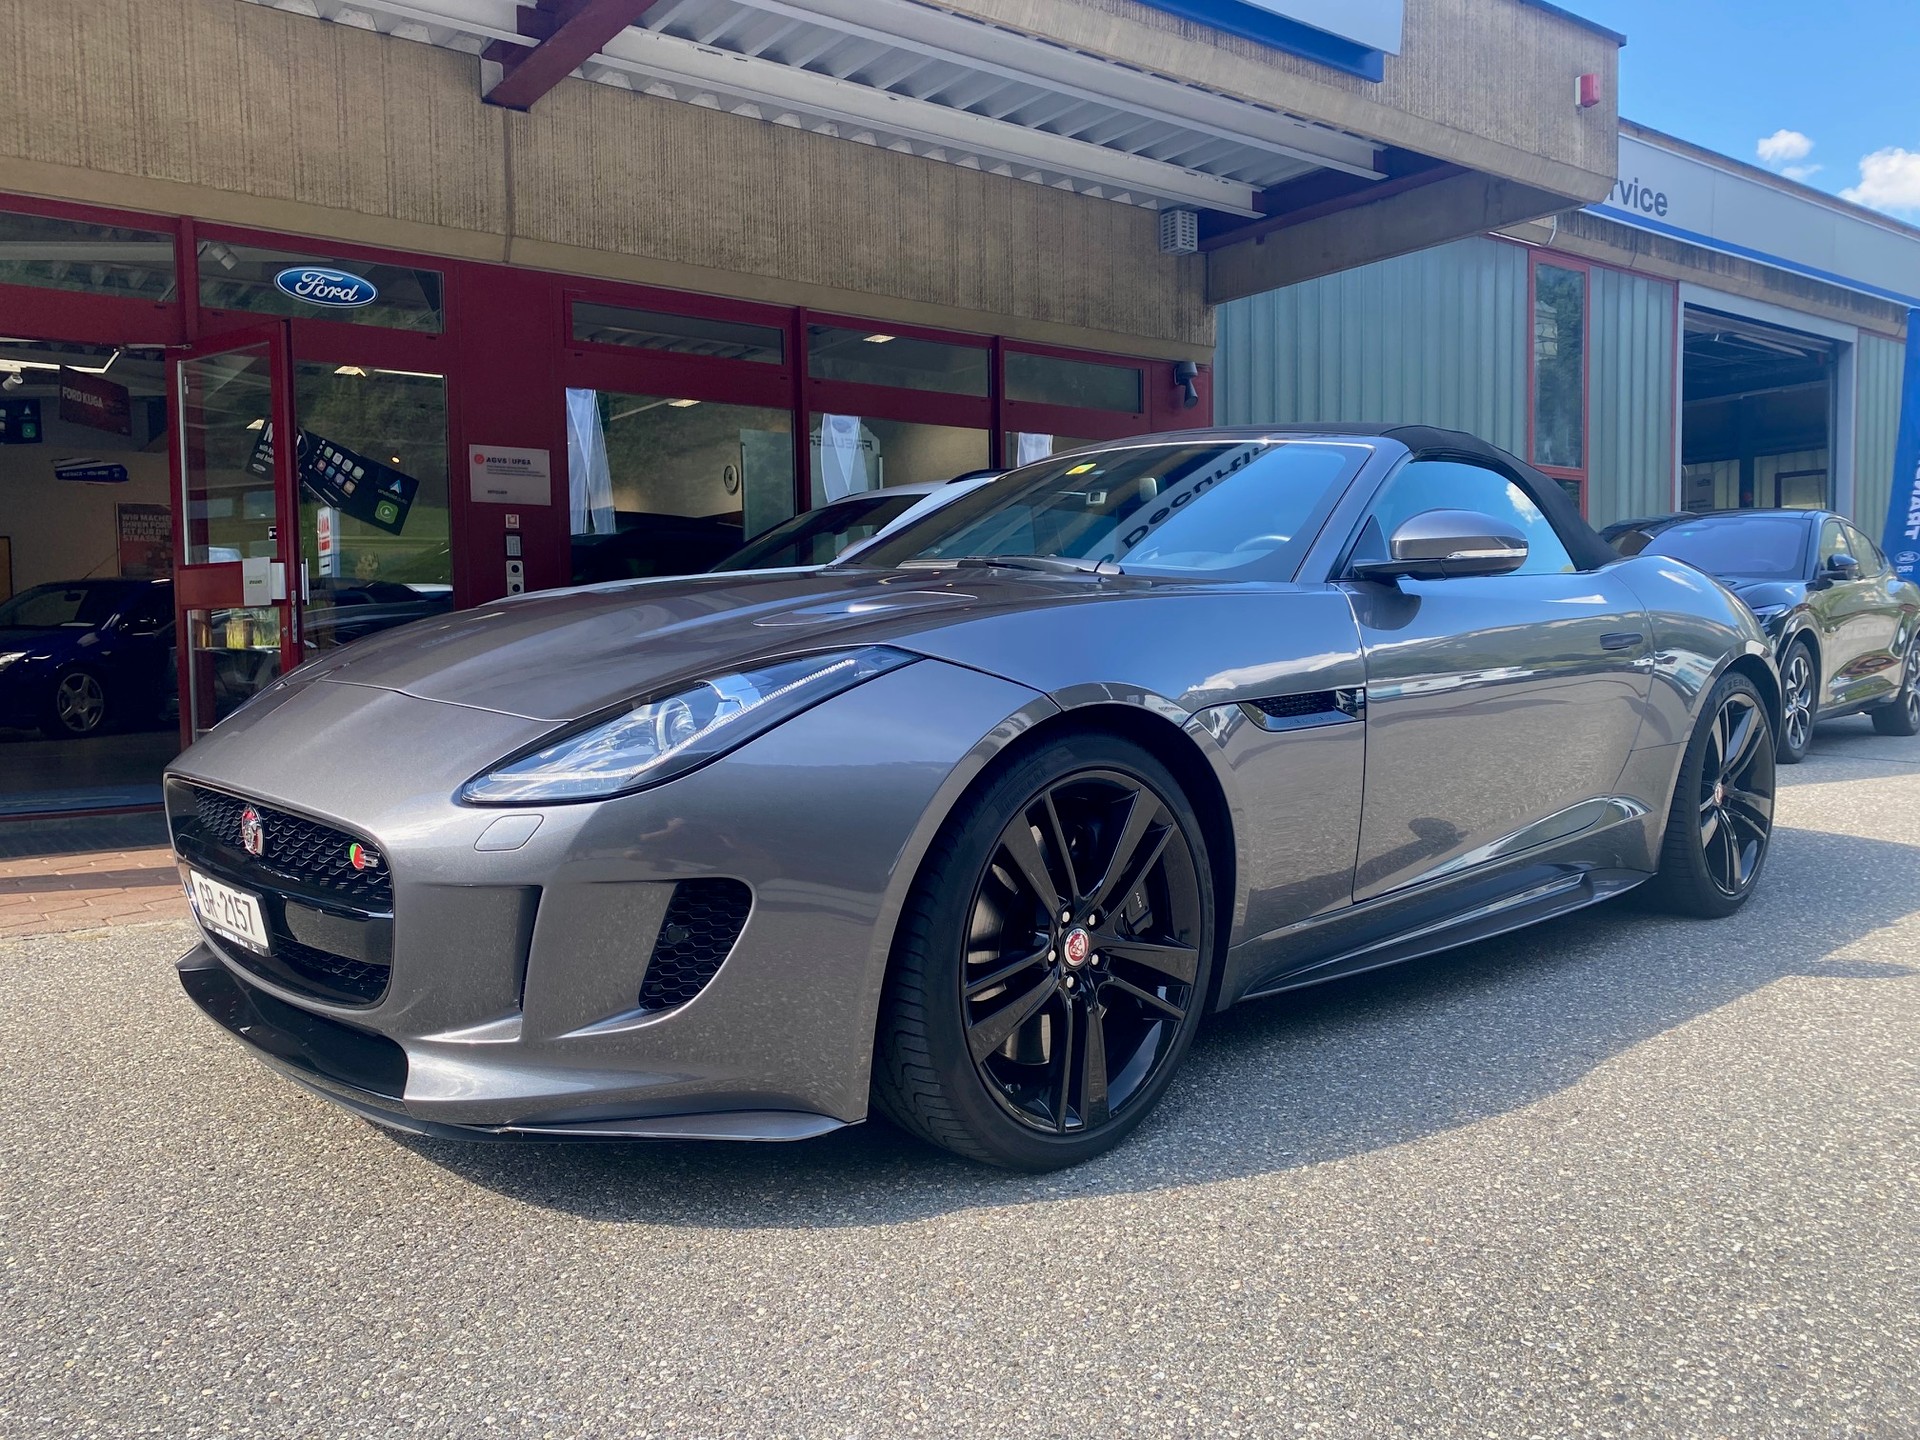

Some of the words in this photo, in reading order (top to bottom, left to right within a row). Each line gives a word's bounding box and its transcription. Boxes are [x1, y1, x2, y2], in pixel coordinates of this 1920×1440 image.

[1609, 177, 1668, 217] rvice
[295, 271, 360, 302] Ford
[486, 456, 507, 464] AGVS
[140, 513, 172, 522] MACHE
